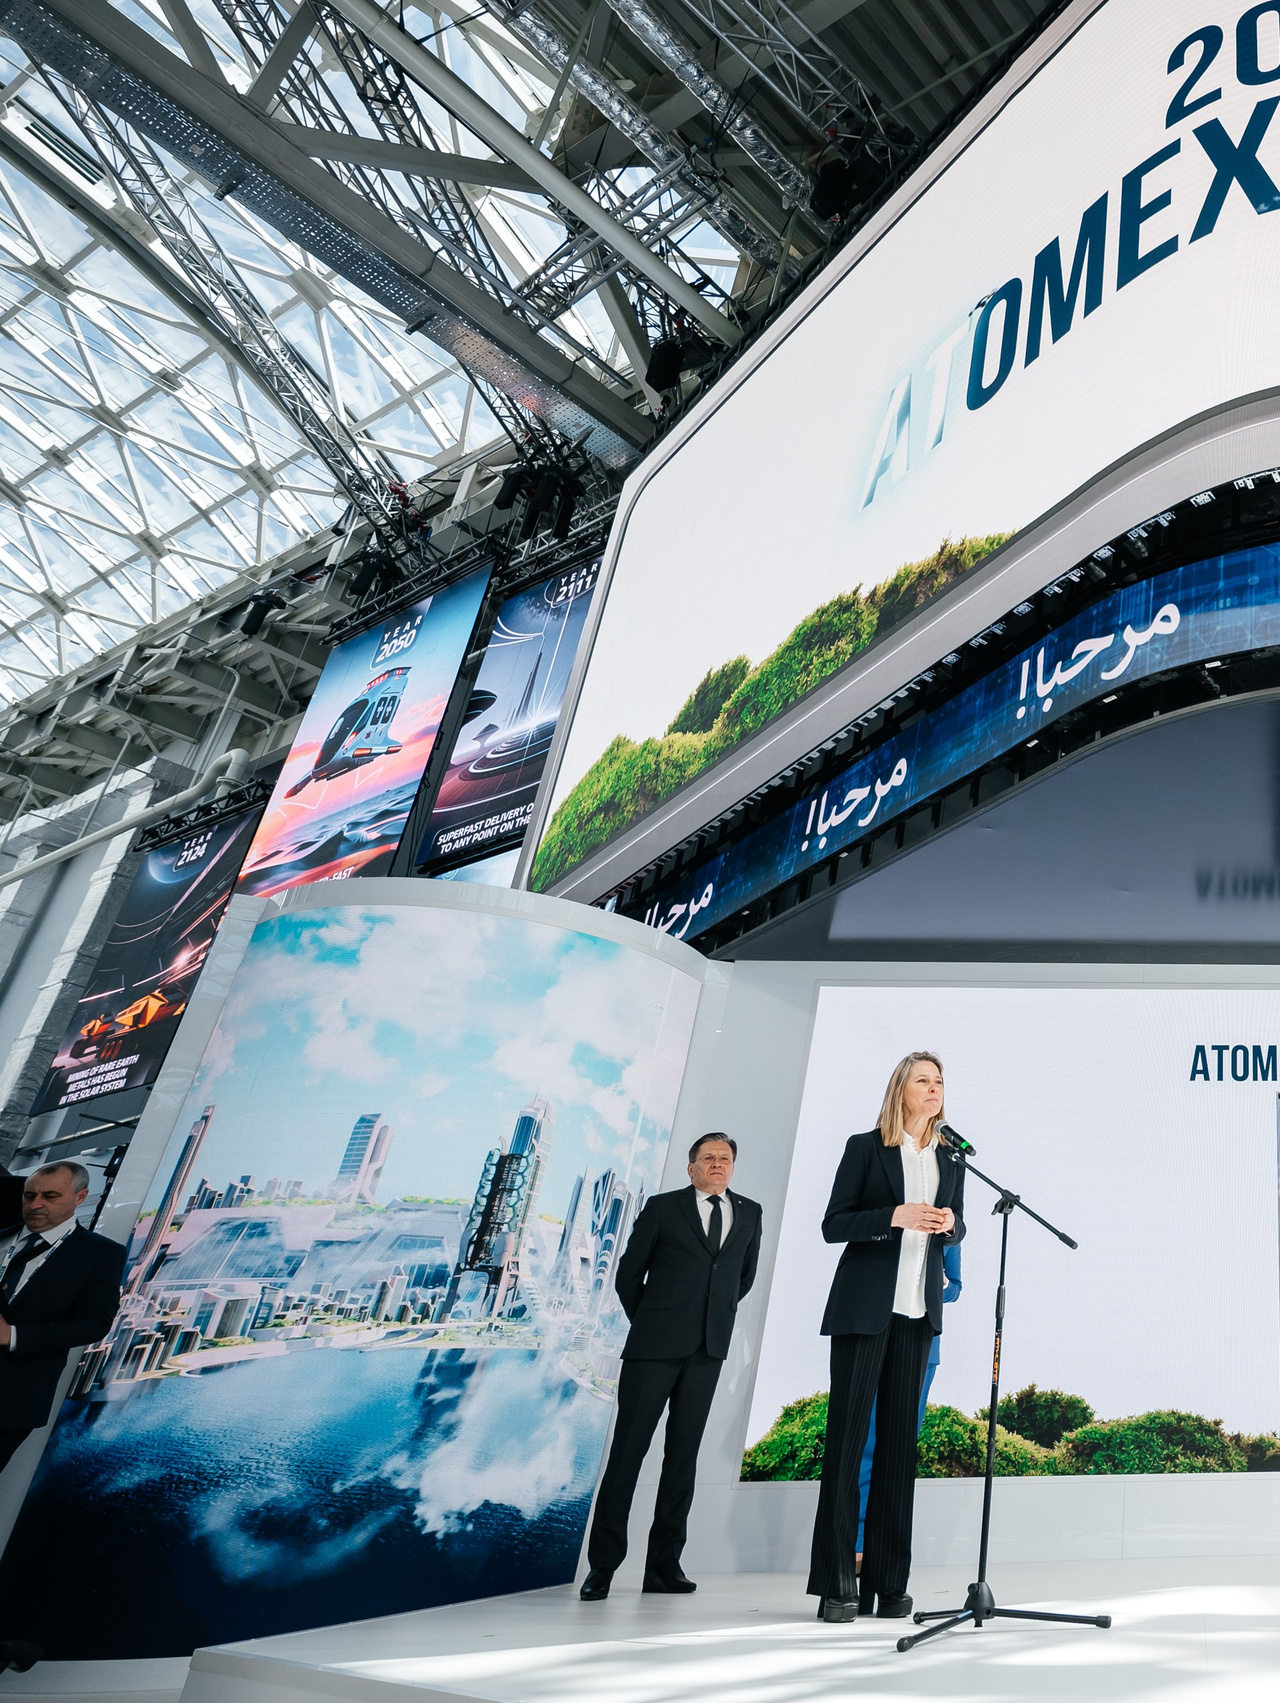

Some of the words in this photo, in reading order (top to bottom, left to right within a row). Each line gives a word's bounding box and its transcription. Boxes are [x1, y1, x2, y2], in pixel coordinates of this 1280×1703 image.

[556, 574, 593, 602] 2111
[560, 563, 598, 586] YEAR
[384, 615, 422, 642] YEAR
[375, 629, 416, 663] 2050
[1015, 603, 1180, 720] مرحبا!
[436, 820, 485, 846] SUPERFAST
[484, 805, 526, 828] DELIVERY
[440, 843, 452, 855] TO
[452, 835, 474, 851] ANY
[471, 826, 500, 844] POINT
[499, 821, 515, 833] ON
[515, 814, 532, 828] THE
[177, 843, 208, 866] 2124
[184, 832, 213, 849] YEAR
